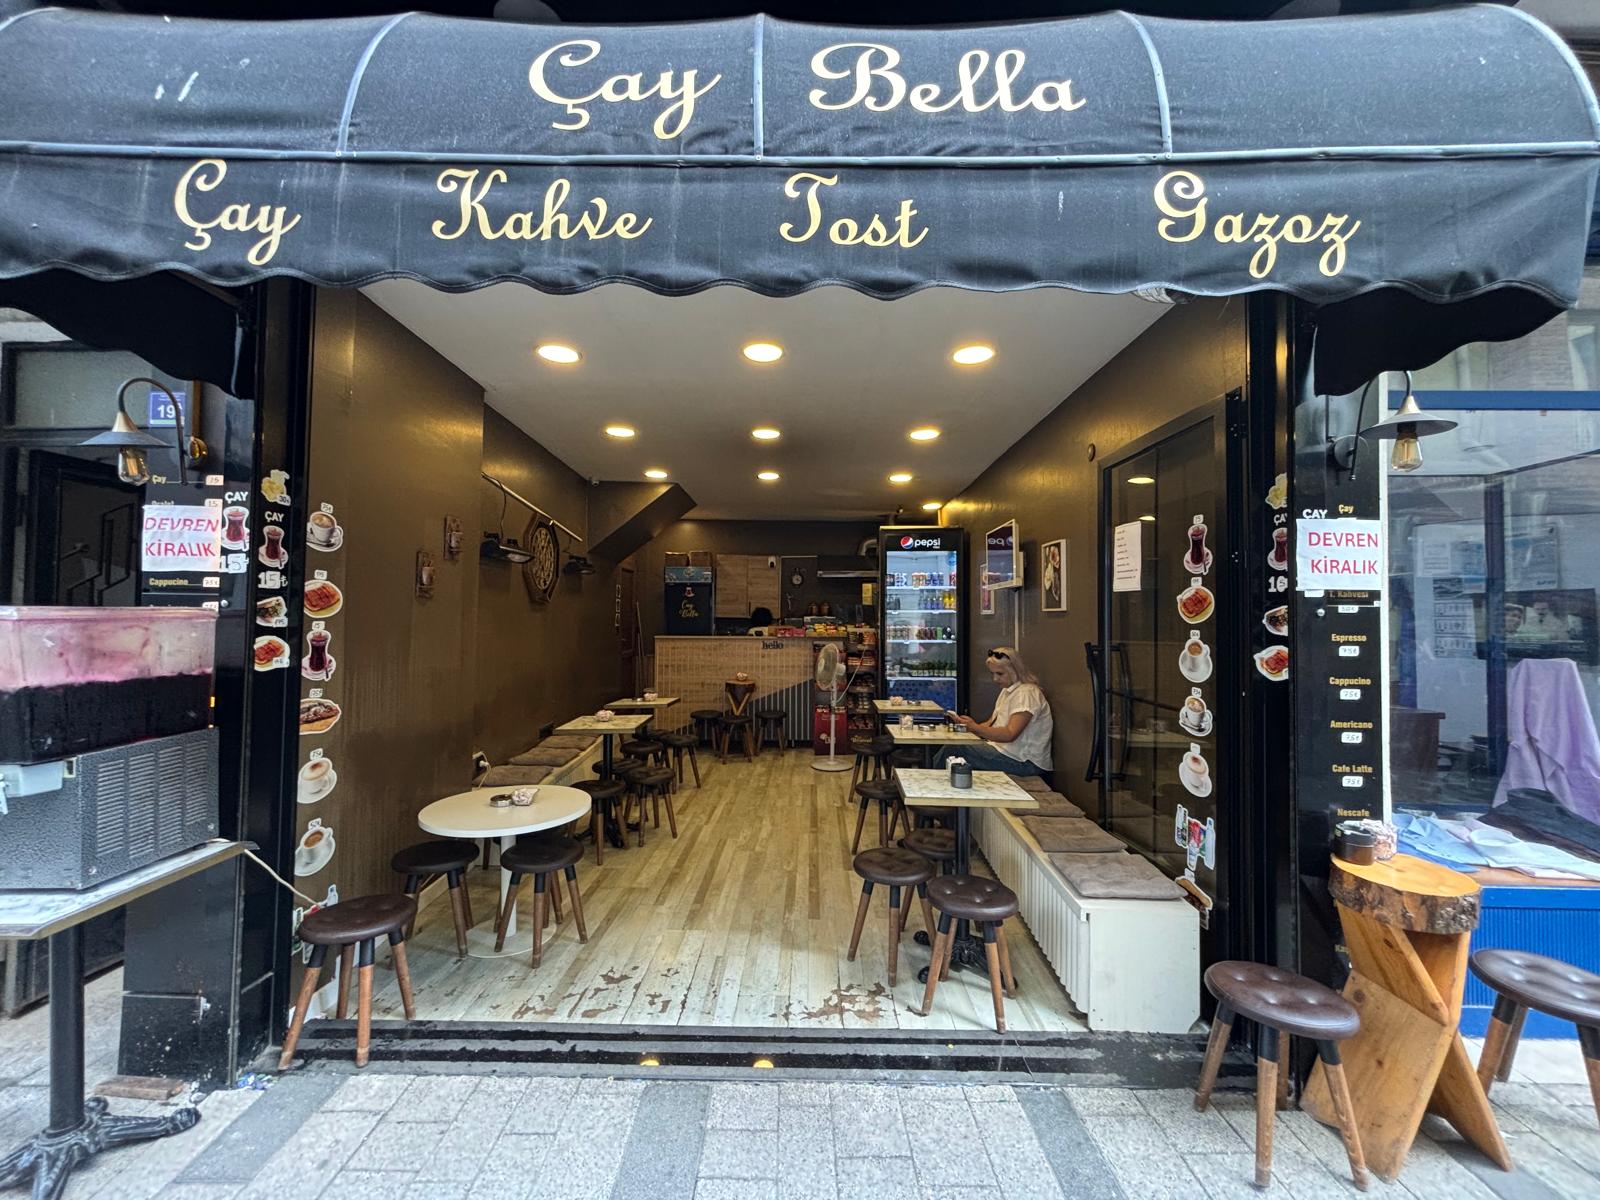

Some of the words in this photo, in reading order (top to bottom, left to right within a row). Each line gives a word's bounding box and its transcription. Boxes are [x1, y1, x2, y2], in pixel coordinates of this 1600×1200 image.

[529, 39, 722, 140] Çay
[809, 42, 1087, 113] Bella
[174, 158, 301, 266] Çay
[432, 167, 653, 241] Kahve
[779, 171, 930, 249] Tost
[1152, 170, 1362, 280] Gazoz
[224, 491, 249, 505] ÇAY
[1338, 504, 1355, 515] Çay
[265, 510, 285, 523] ÇAY
[144, 517, 219, 532] DEVREN
[914, 537, 941, 549] pepsi
[1308, 531, 1379, 547] DEVREN
[145, 538, 216, 557] KİRALIK
[1310, 555, 1379, 574] KİRALIK
[1331, 633, 1367, 643] Espresso
[762, 640, 784, 650] hello
[1329, 676, 1372, 687] Cappucino
[1329, 720, 1373, 729] Americano
[1332, 764, 1351, 773] Cafe
[1352, 764, 1373, 773] Latte
[1337, 808, 1370, 817] Nescafe
